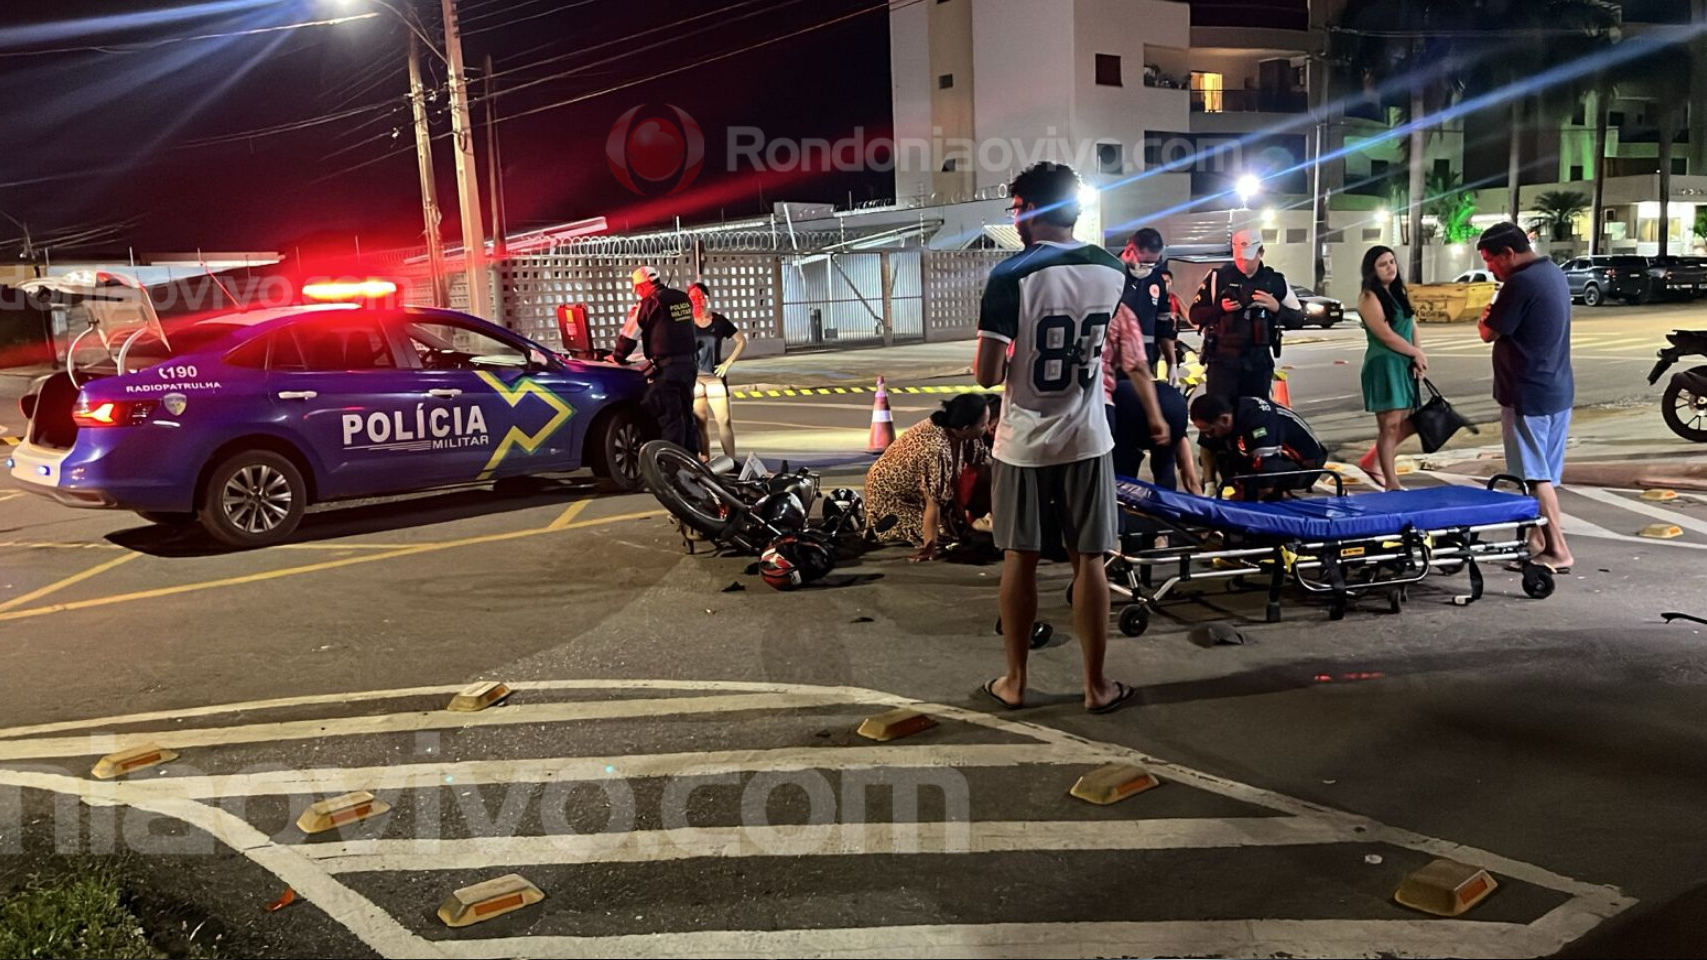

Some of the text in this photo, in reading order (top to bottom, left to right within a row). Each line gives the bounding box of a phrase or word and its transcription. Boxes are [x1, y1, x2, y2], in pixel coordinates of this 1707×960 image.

[167, 365, 197, 378] 190
[126, 381, 222, 393] RADIOPATRULHA
[342, 403, 488, 445] POLÍCIA
[432, 434, 489, 450] MILITAR
